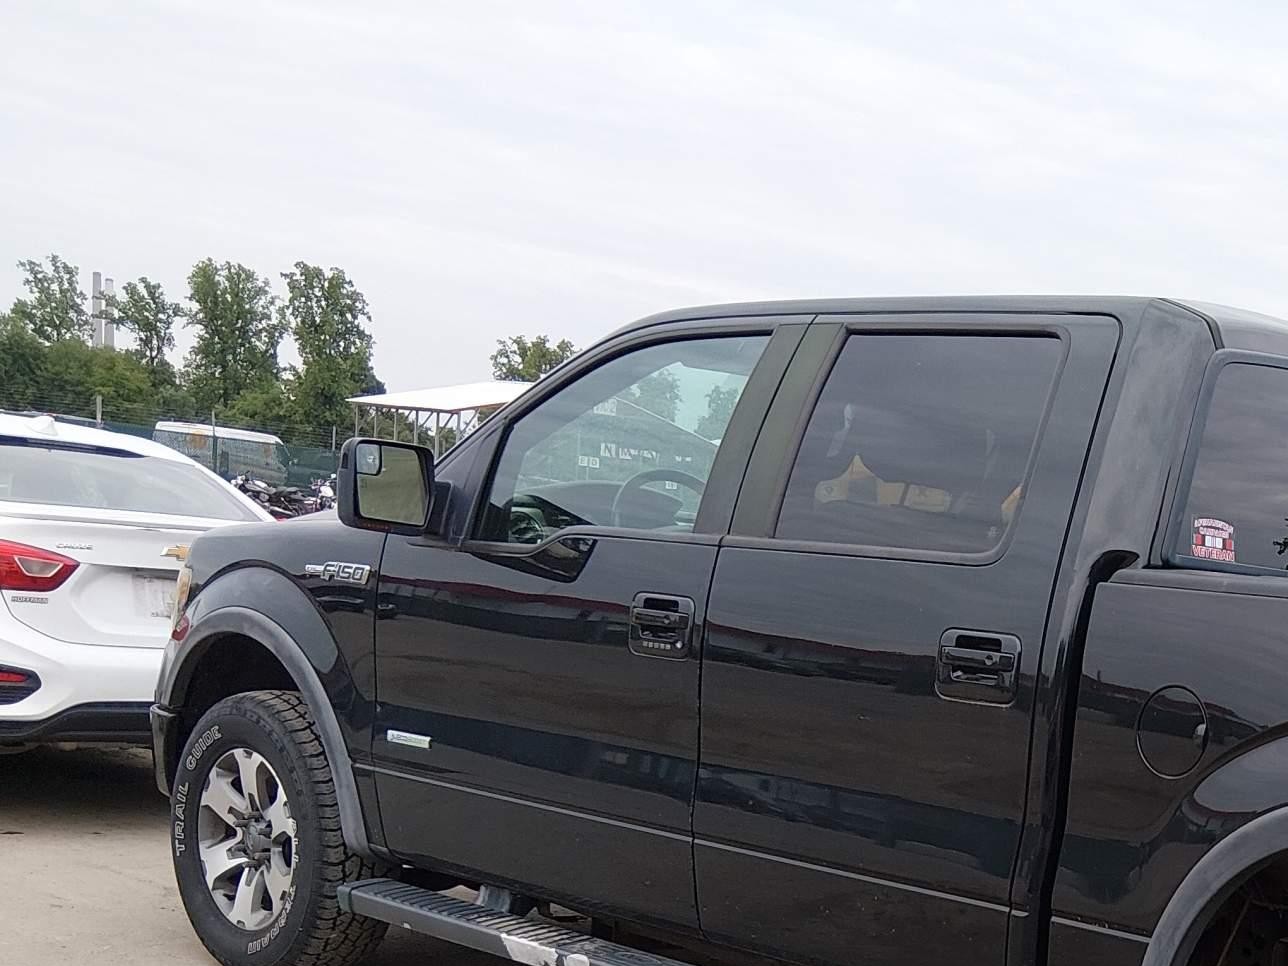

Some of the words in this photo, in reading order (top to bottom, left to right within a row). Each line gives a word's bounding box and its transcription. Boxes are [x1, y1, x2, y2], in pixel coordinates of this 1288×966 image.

[1192, 544, 1235, 562] VETERAN
[175, 781, 190, 857] TRAIL
[185, 724, 223, 771] GUIDE
